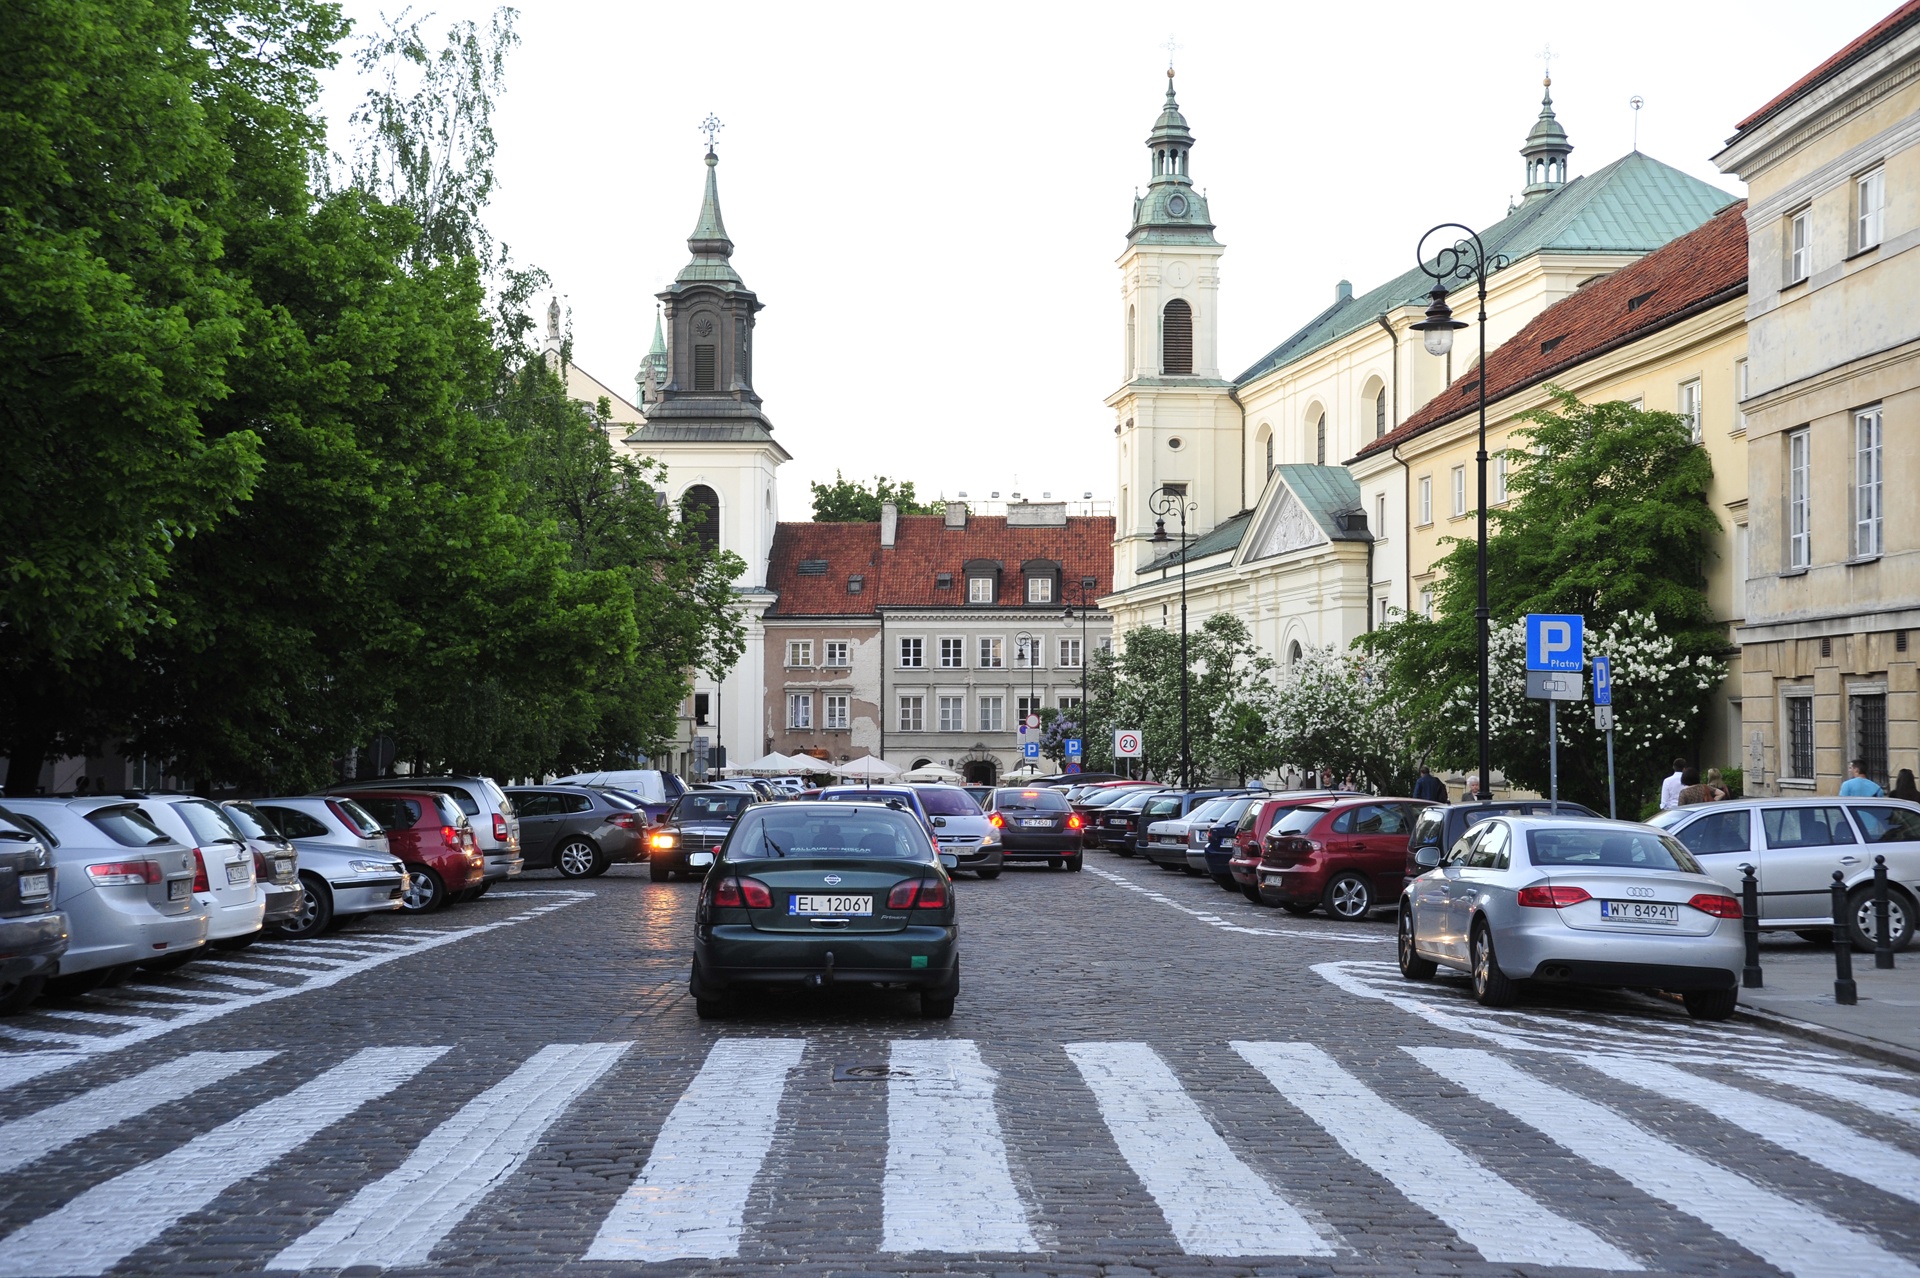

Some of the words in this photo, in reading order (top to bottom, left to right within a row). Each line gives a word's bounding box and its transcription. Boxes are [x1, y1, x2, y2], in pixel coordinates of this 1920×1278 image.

[1540, 621, 1571, 664] P
[1551, 660, 1580, 670] Płatny
[1596, 662, 1606, 698] P
[1028, 744, 1037, 756] P
[1068, 741, 1078, 754] P
[1122, 739, 1135, 748] 20
[798, 897, 818, 912] EL
[826, 897, 870, 912] 1206Y
[1610, 903, 1629, 916] WY
[1634, 904, 1675, 918] 8494Y
